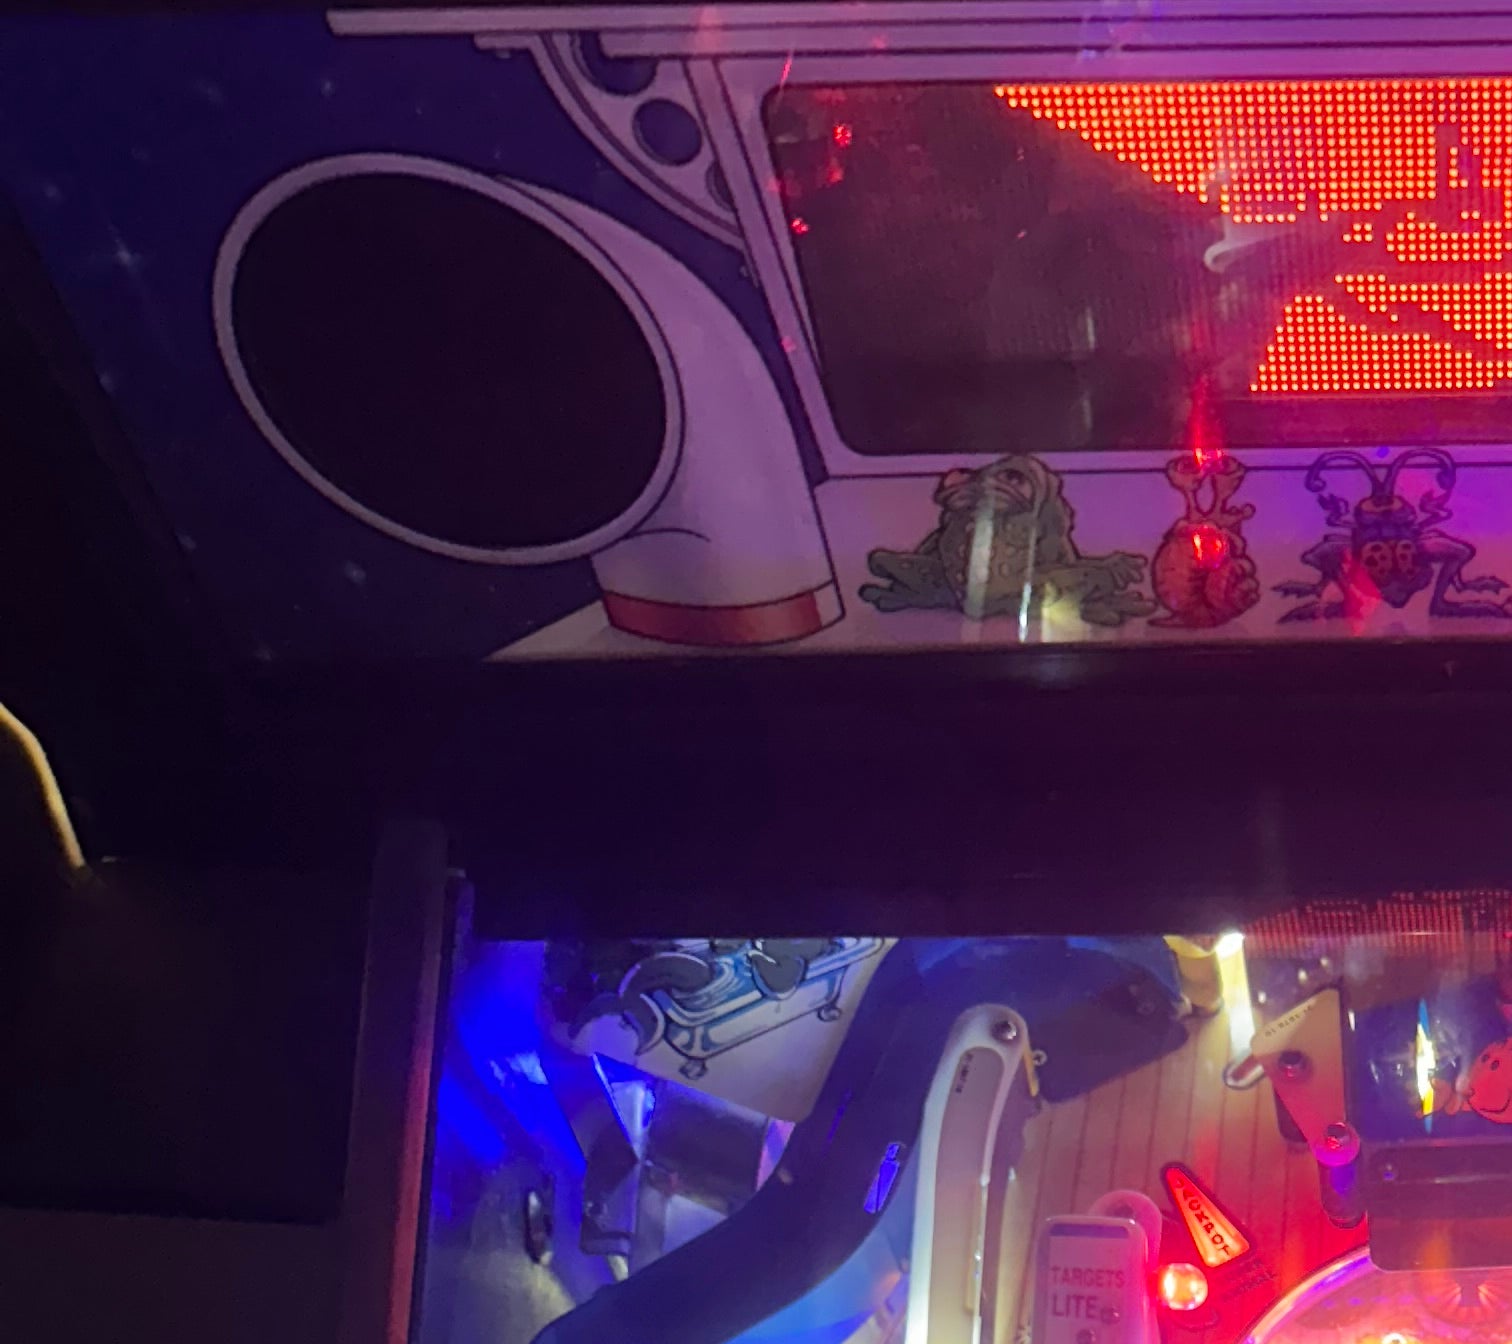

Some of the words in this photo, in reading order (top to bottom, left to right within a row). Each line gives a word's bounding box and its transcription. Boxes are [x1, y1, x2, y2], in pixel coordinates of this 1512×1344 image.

[1174, 1178, 1231, 1257] JACKPOT
[1050, 1265, 1125, 1289] TARGETS
[1052, 1293, 1098, 1319] LITE
